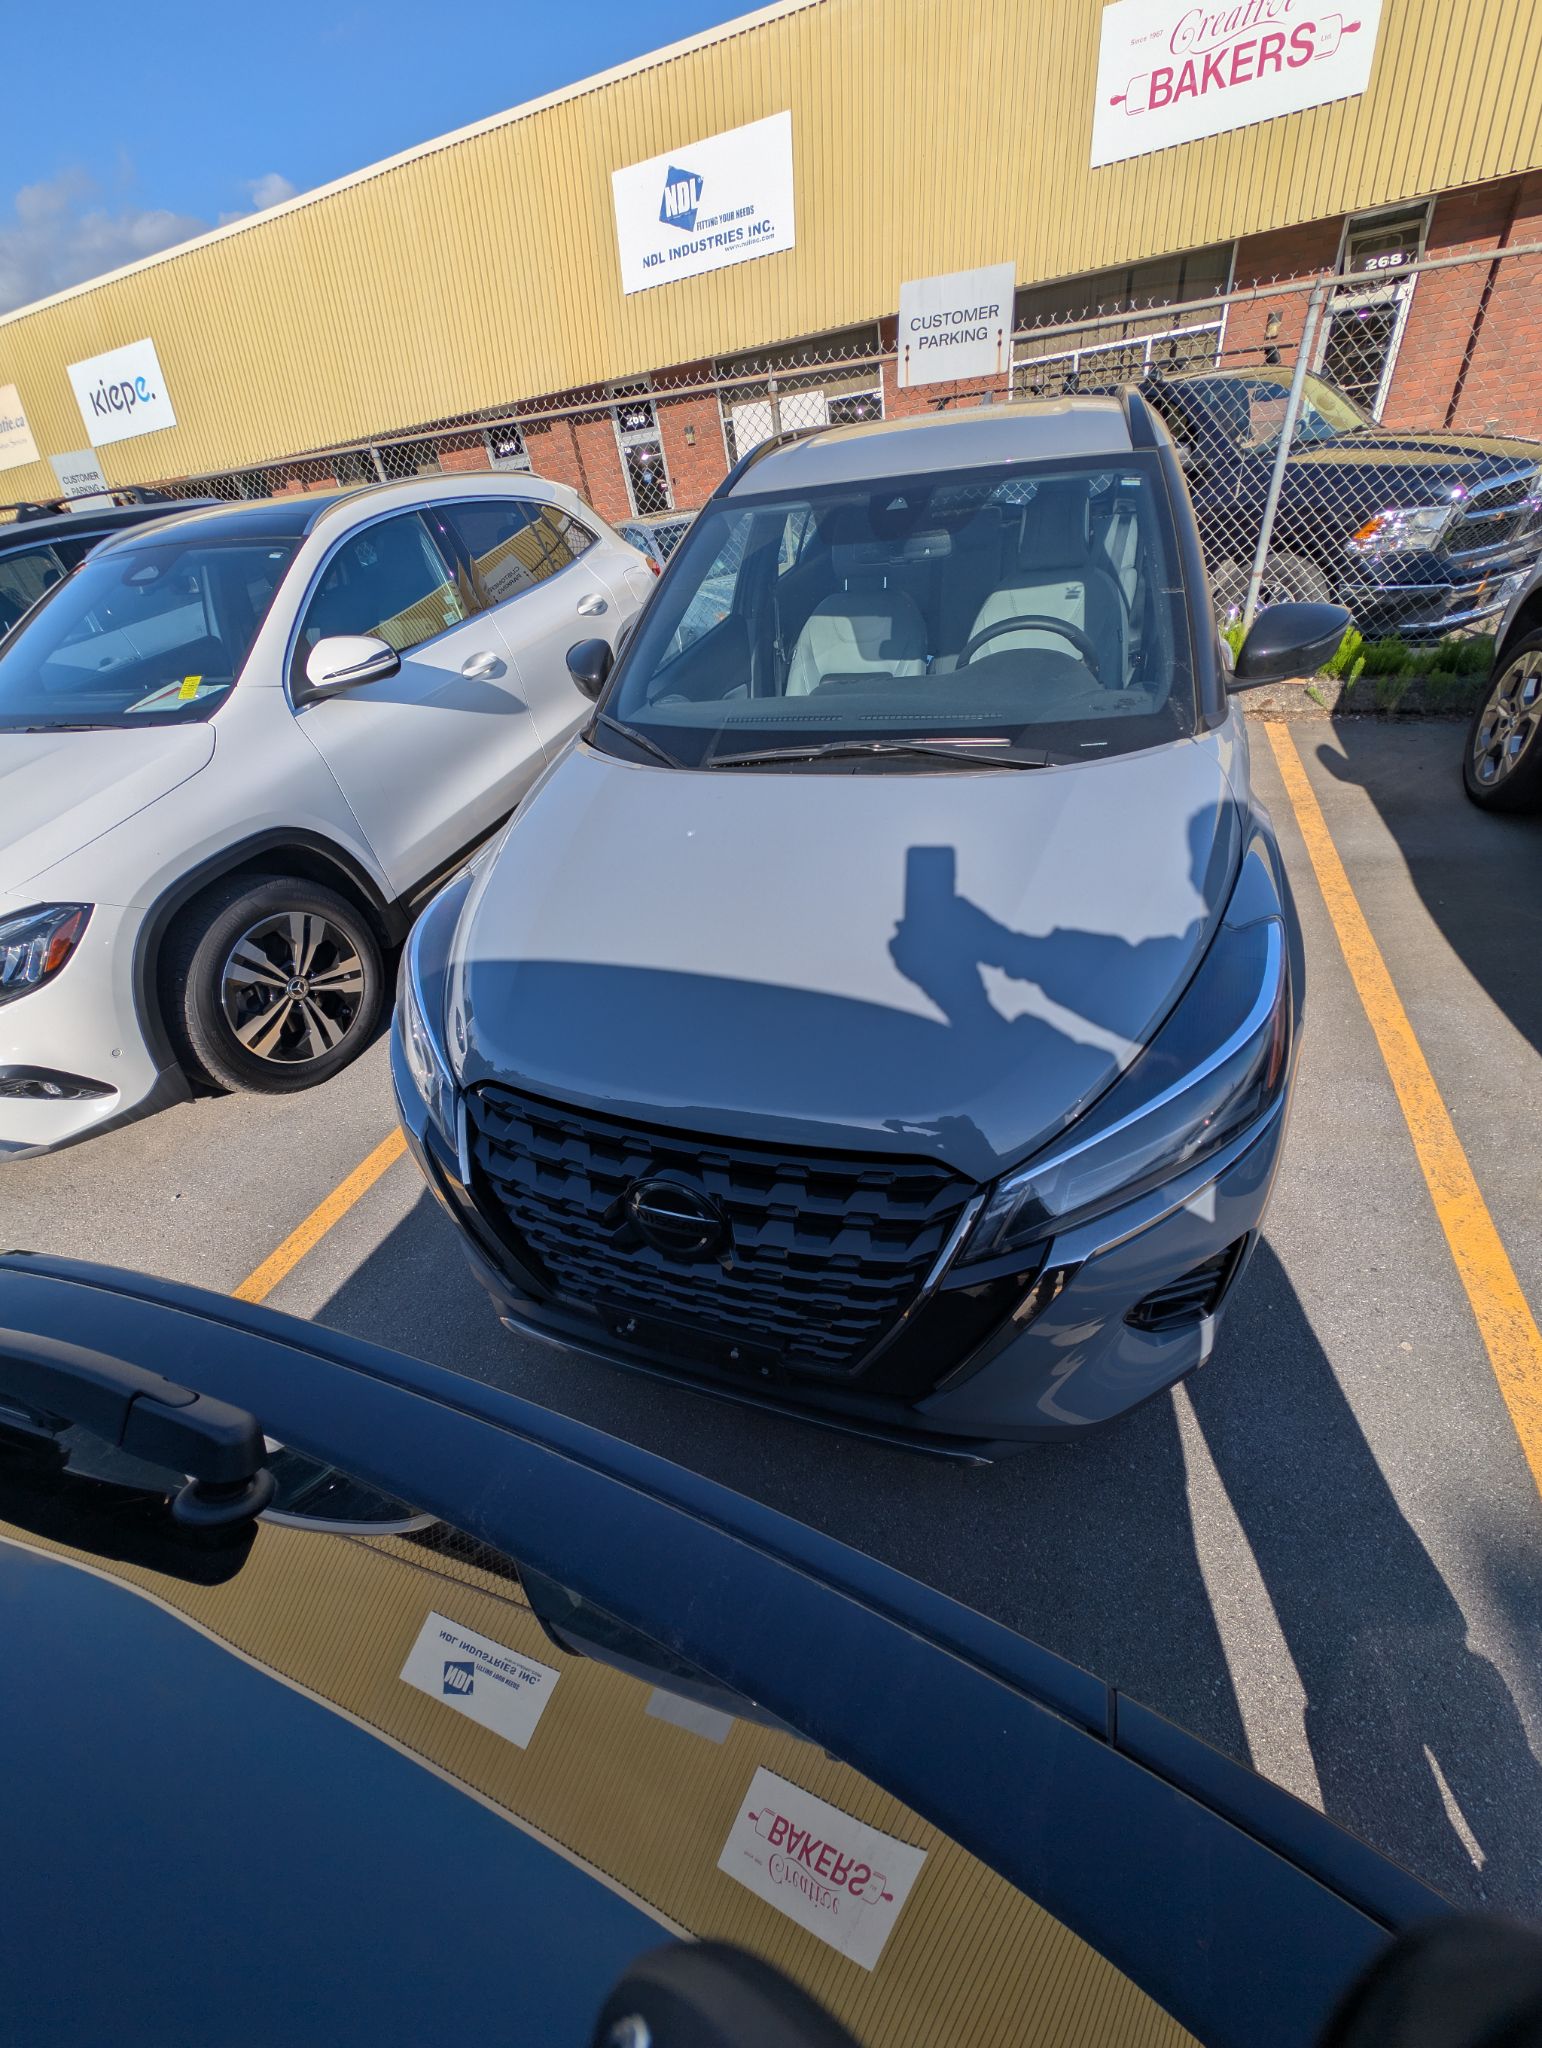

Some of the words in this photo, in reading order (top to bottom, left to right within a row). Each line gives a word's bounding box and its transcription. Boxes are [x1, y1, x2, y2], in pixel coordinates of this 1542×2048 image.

[1148, 21, 1317, 111] BAKERS
[664, 178, 699, 218] NDL
[696, 216, 719, 231] FITTING
[719, 211, 735, 224] YOUR
[735, 205, 755, 219] NEEDS
[642, 254, 666, 269] NDL
[668, 227, 744, 261] INDUSTRIES
[748, 219, 775, 238] INC.
[1365, 253, 1403, 271] 268
[910, 304, 1000, 332] CUSTOMER
[918, 326, 989, 350] PARKING
[62, 471, 100, 485] CUSTOMER
[71, 484, 100, 496] PARKING
